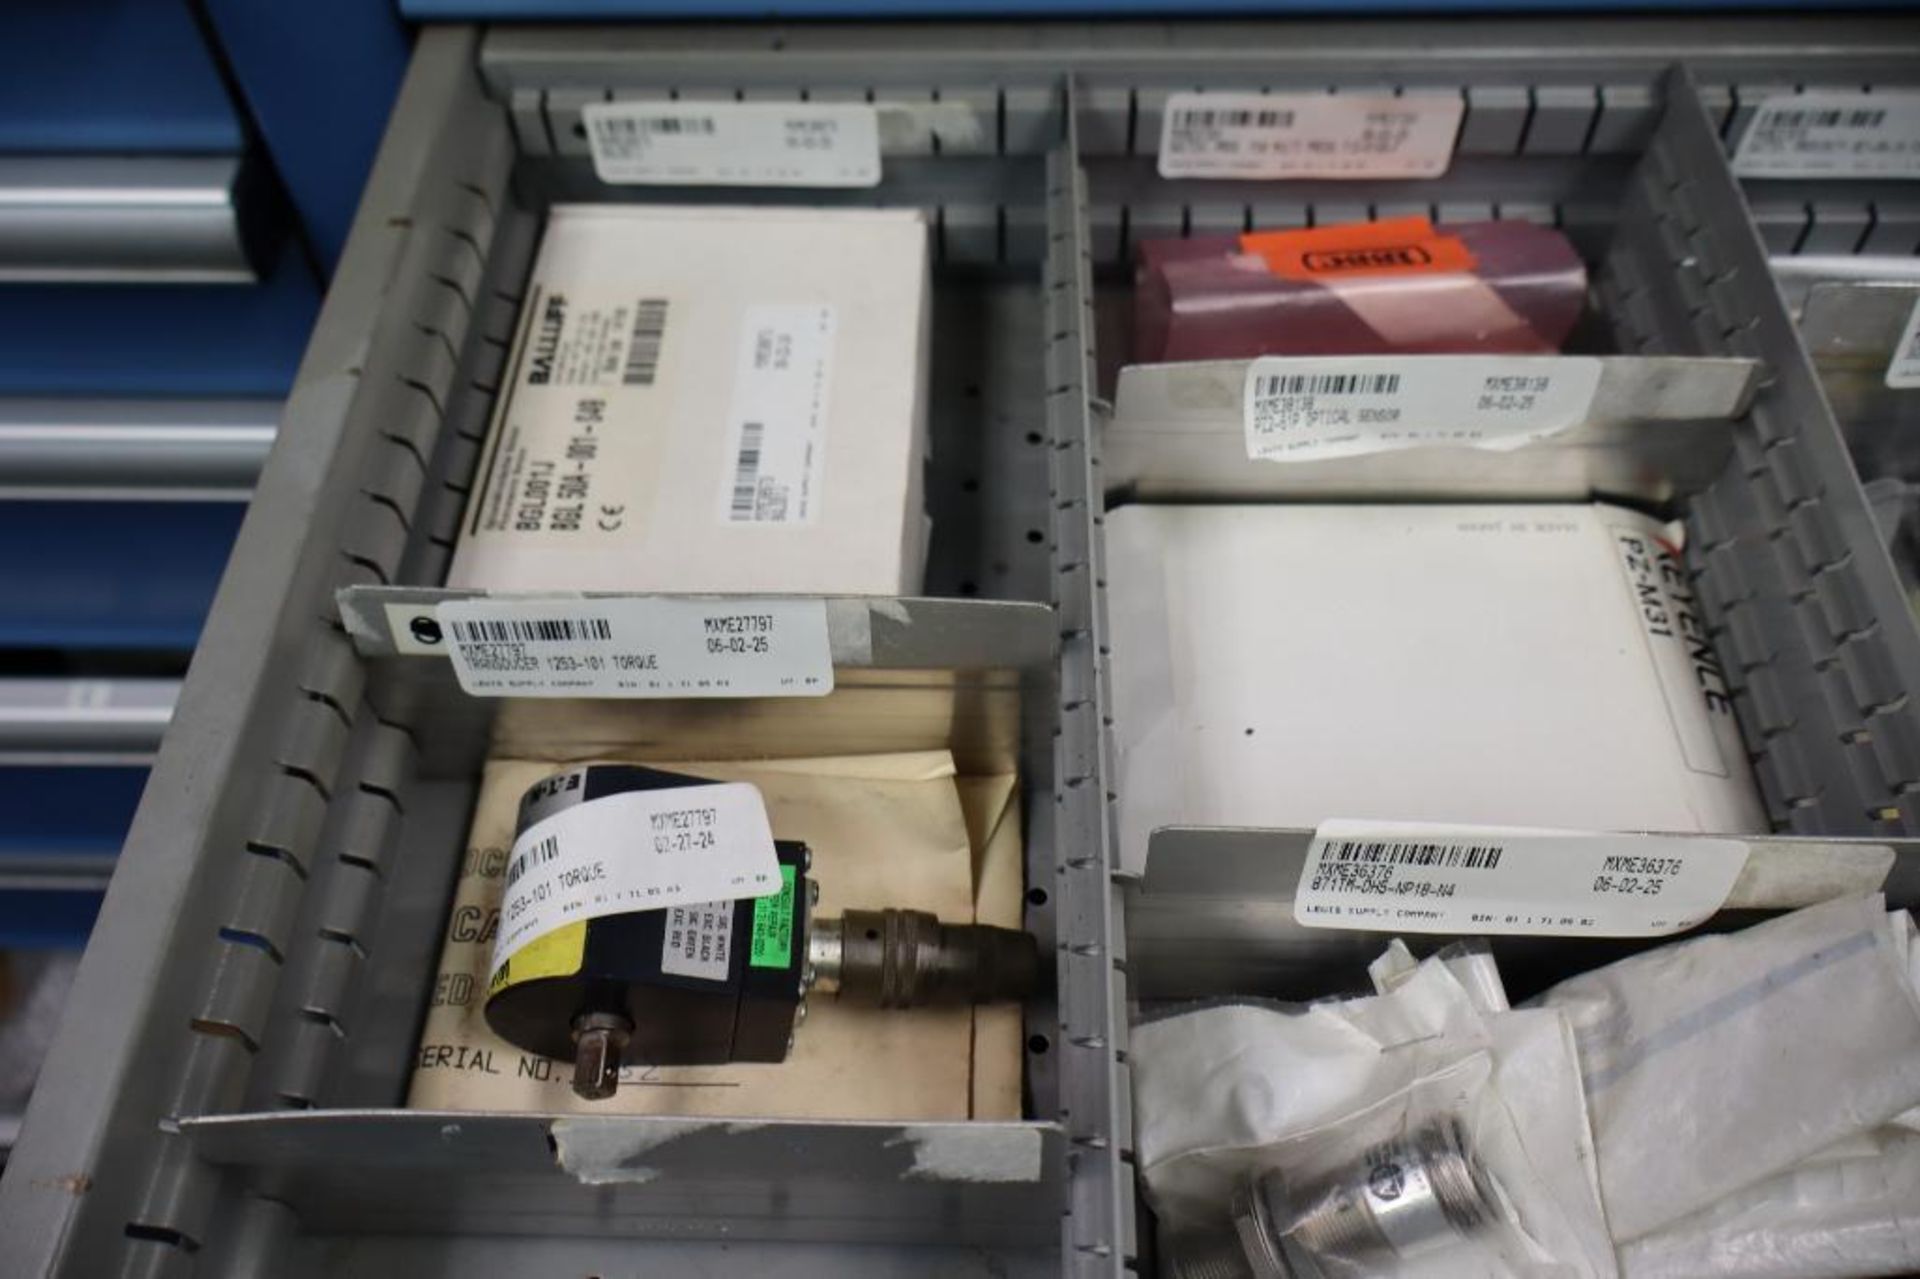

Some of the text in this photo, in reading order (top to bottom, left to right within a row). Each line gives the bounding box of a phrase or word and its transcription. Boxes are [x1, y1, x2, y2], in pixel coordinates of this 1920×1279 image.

[528, 295, 568, 385] BALLUFF
[550, 503, 584, 530] BGL
[1620, 535, 1673, 638] PZ-M31
[704, 615, 773, 633] MXME27797
[707, 636, 768, 653] 06-02-25
[547, 655, 605, 671] 1253-101
[612, 655, 658, 670] TORQUE
[650, 808, 716, 829] MXME27797
[558, 861, 606, 889] TORQUE
[1317, 863, 1394, 880] MXME36376
[1603, 856, 1683, 875] MXME36376
[1593, 876, 1663, 895] 06-02-25
[517, 1056, 561, 1083] NO.
